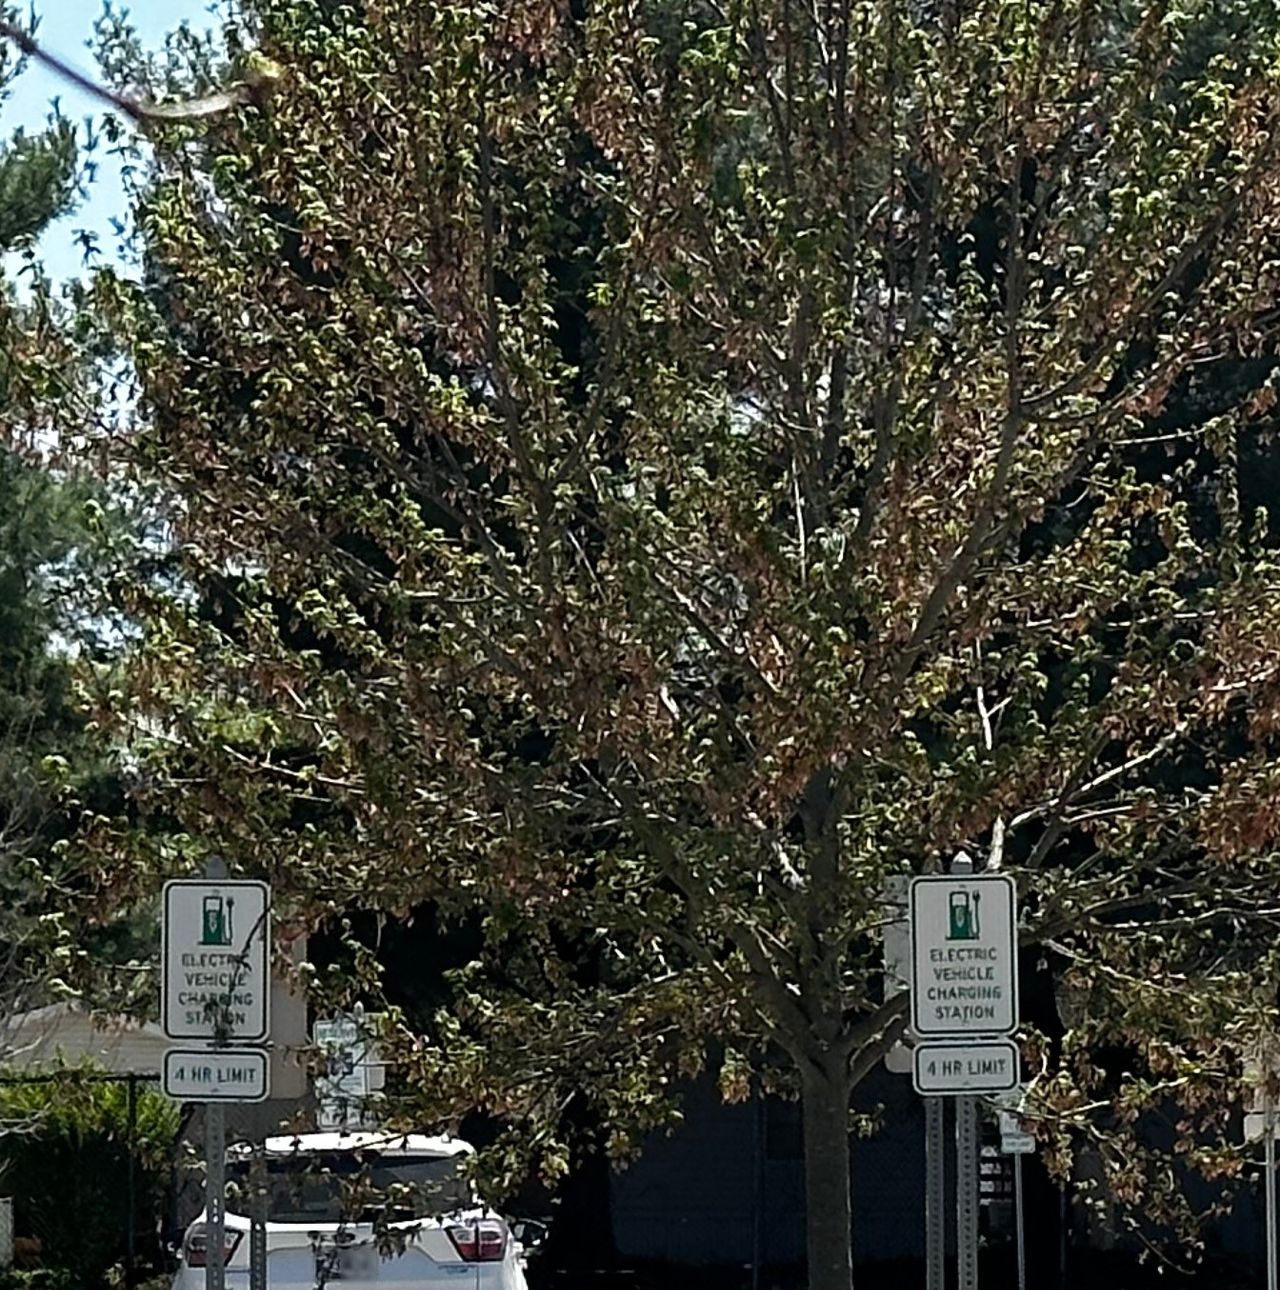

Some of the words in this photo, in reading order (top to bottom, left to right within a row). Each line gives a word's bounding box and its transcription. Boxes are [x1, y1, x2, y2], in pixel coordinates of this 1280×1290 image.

[181, 953, 250, 968] ELECTR
[929, 948, 998, 963] ELECTRIC
[933, 967, 995, 981] VEHICLE
[178, 991, 254, 1006] CHARNG
[927, 986, 1002, 1001] CHARGING
[185, 1010, 246, 1025] STAON
[935, 1005, 995, 1020] STATION
[174, 1069, 185, 1083] 4
[191, 1068, 212, 1083] HR
[217, 1067, 257, 1083] LIMIT
[926, 1062, 936, 1077] 4
[942, 1062, 962, 1076] HR
[967, 1061, 1007, 1076] LIMIT
